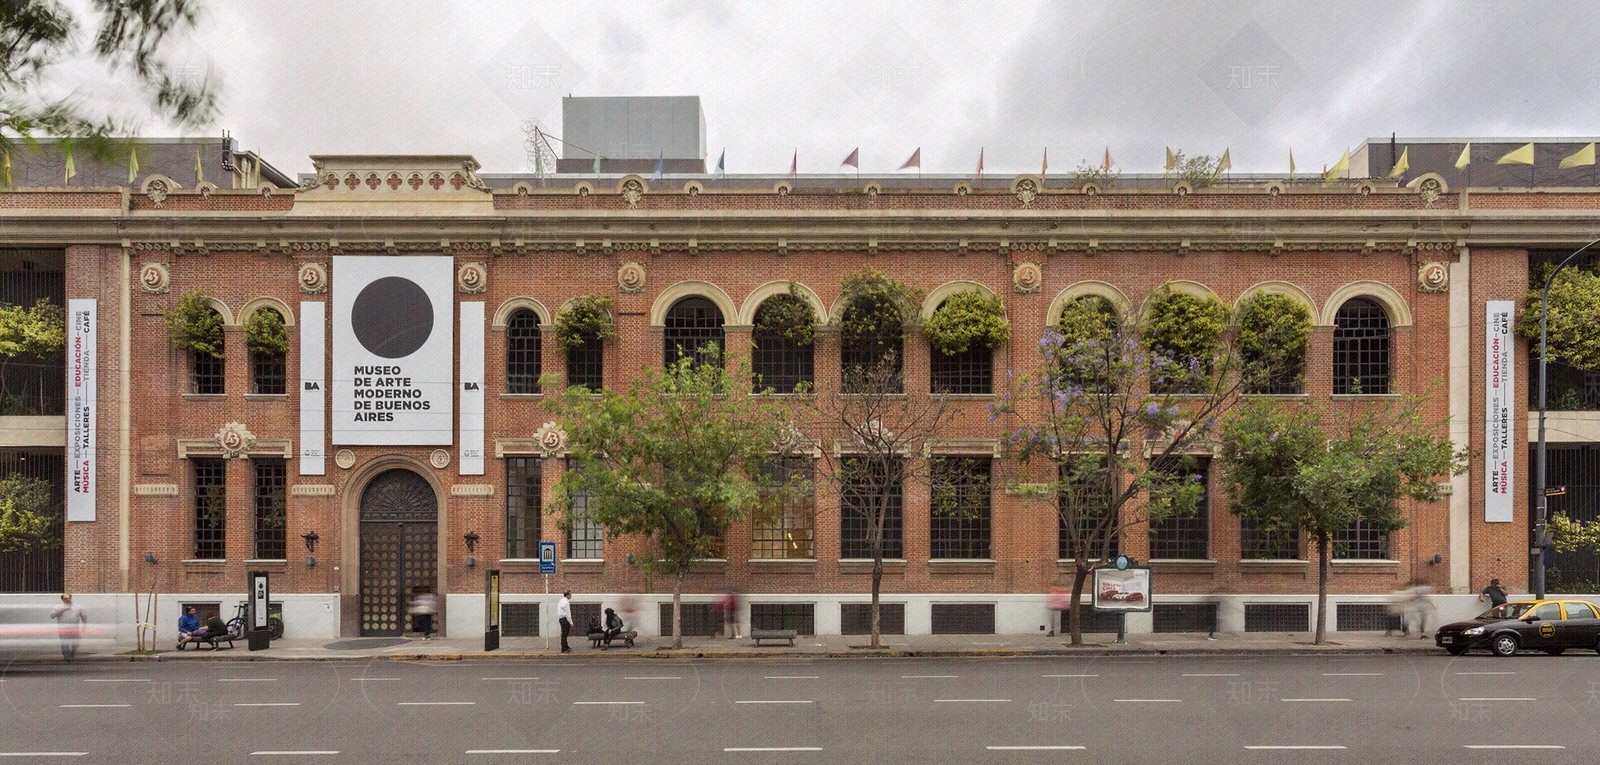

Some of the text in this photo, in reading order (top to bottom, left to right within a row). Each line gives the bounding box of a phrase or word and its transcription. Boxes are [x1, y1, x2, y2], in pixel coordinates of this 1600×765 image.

[1500, 311, 1508, 334] CAFÉ
[73, 336, 81, 387] EDUCACIÓN
[1491, 338, 1499, 388] EDUCACIÓN
[354, 366, 401, 375] MUSEO
[304, 382, 320, 390] BA
[354, 378, 411, 387] DE ARTE
[464, 382, 480, 390] BA
[354, 389, 422, 398] MODERNO
[81, 310, 90, 494] MÚSICA TALLERES TIENDA CAFÉ
[354, 401, 431, 410] DE BUENOS
[354, 412, 394, 421] AIRES
[1500, 461, 1508, 494] MÚSICA
